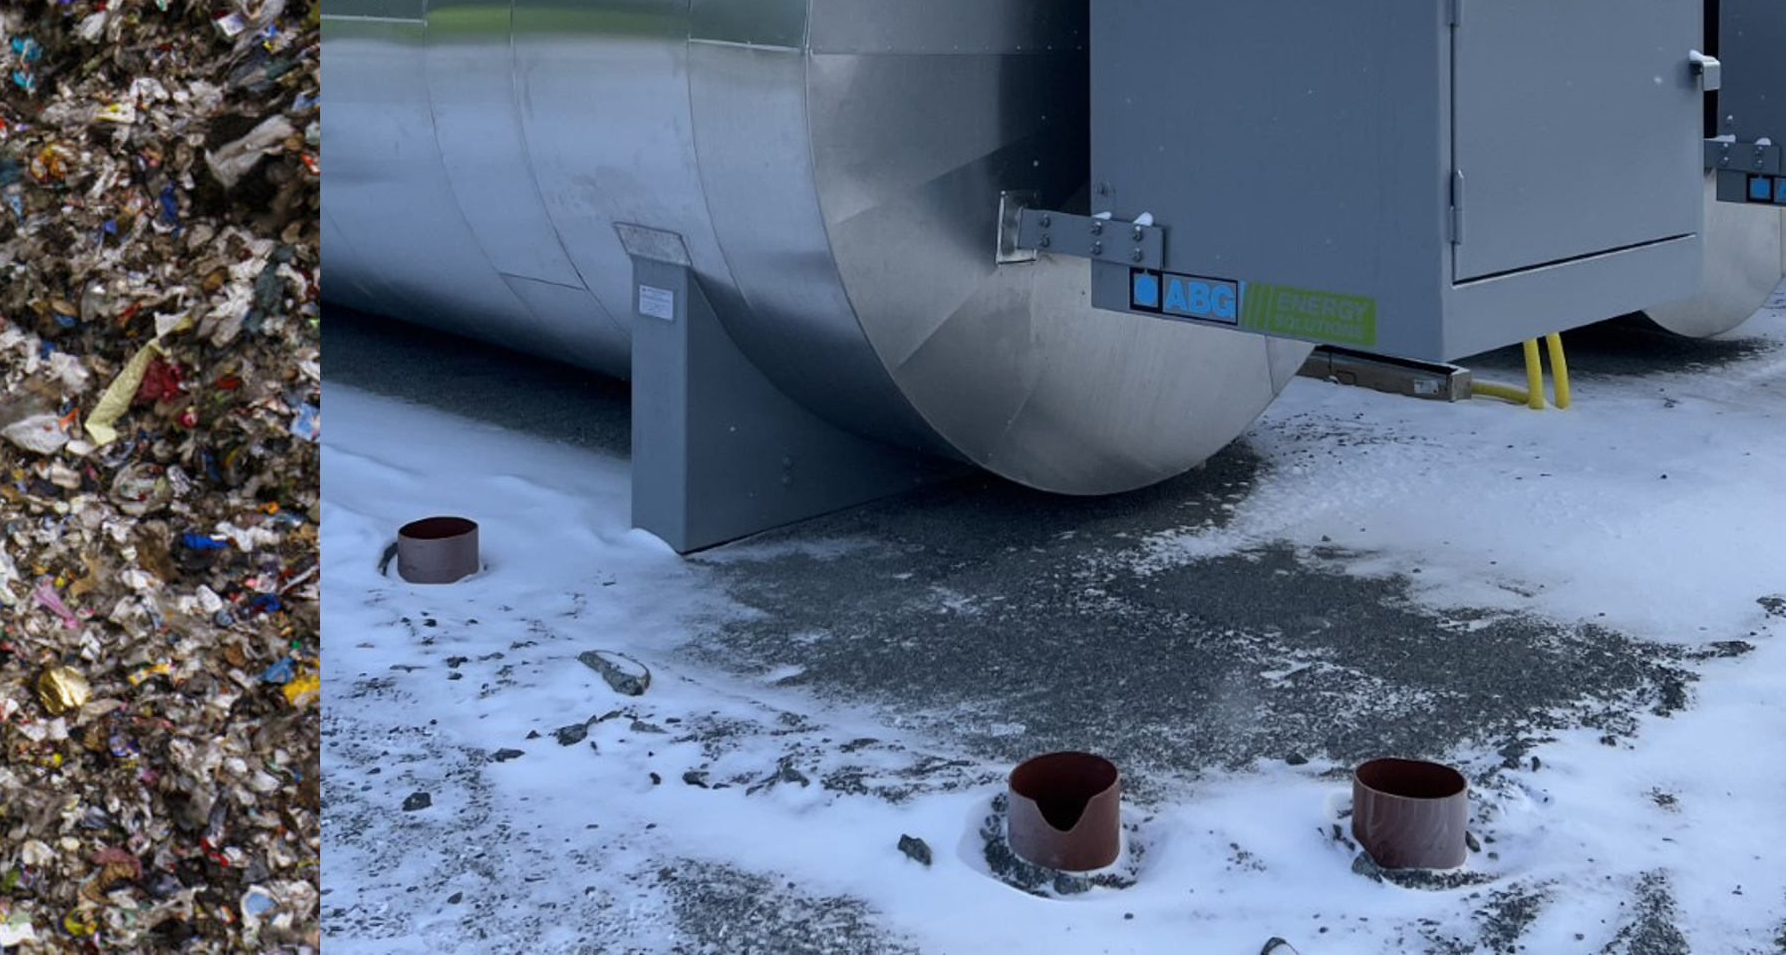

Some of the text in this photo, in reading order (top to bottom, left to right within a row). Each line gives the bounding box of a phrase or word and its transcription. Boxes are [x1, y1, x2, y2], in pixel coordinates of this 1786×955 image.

[1165, 278, 1236, 319] ABG
[1277, 292, 1370, 321] ENERGY
[1274, 314, 1364, 341] SOLUTIONS
